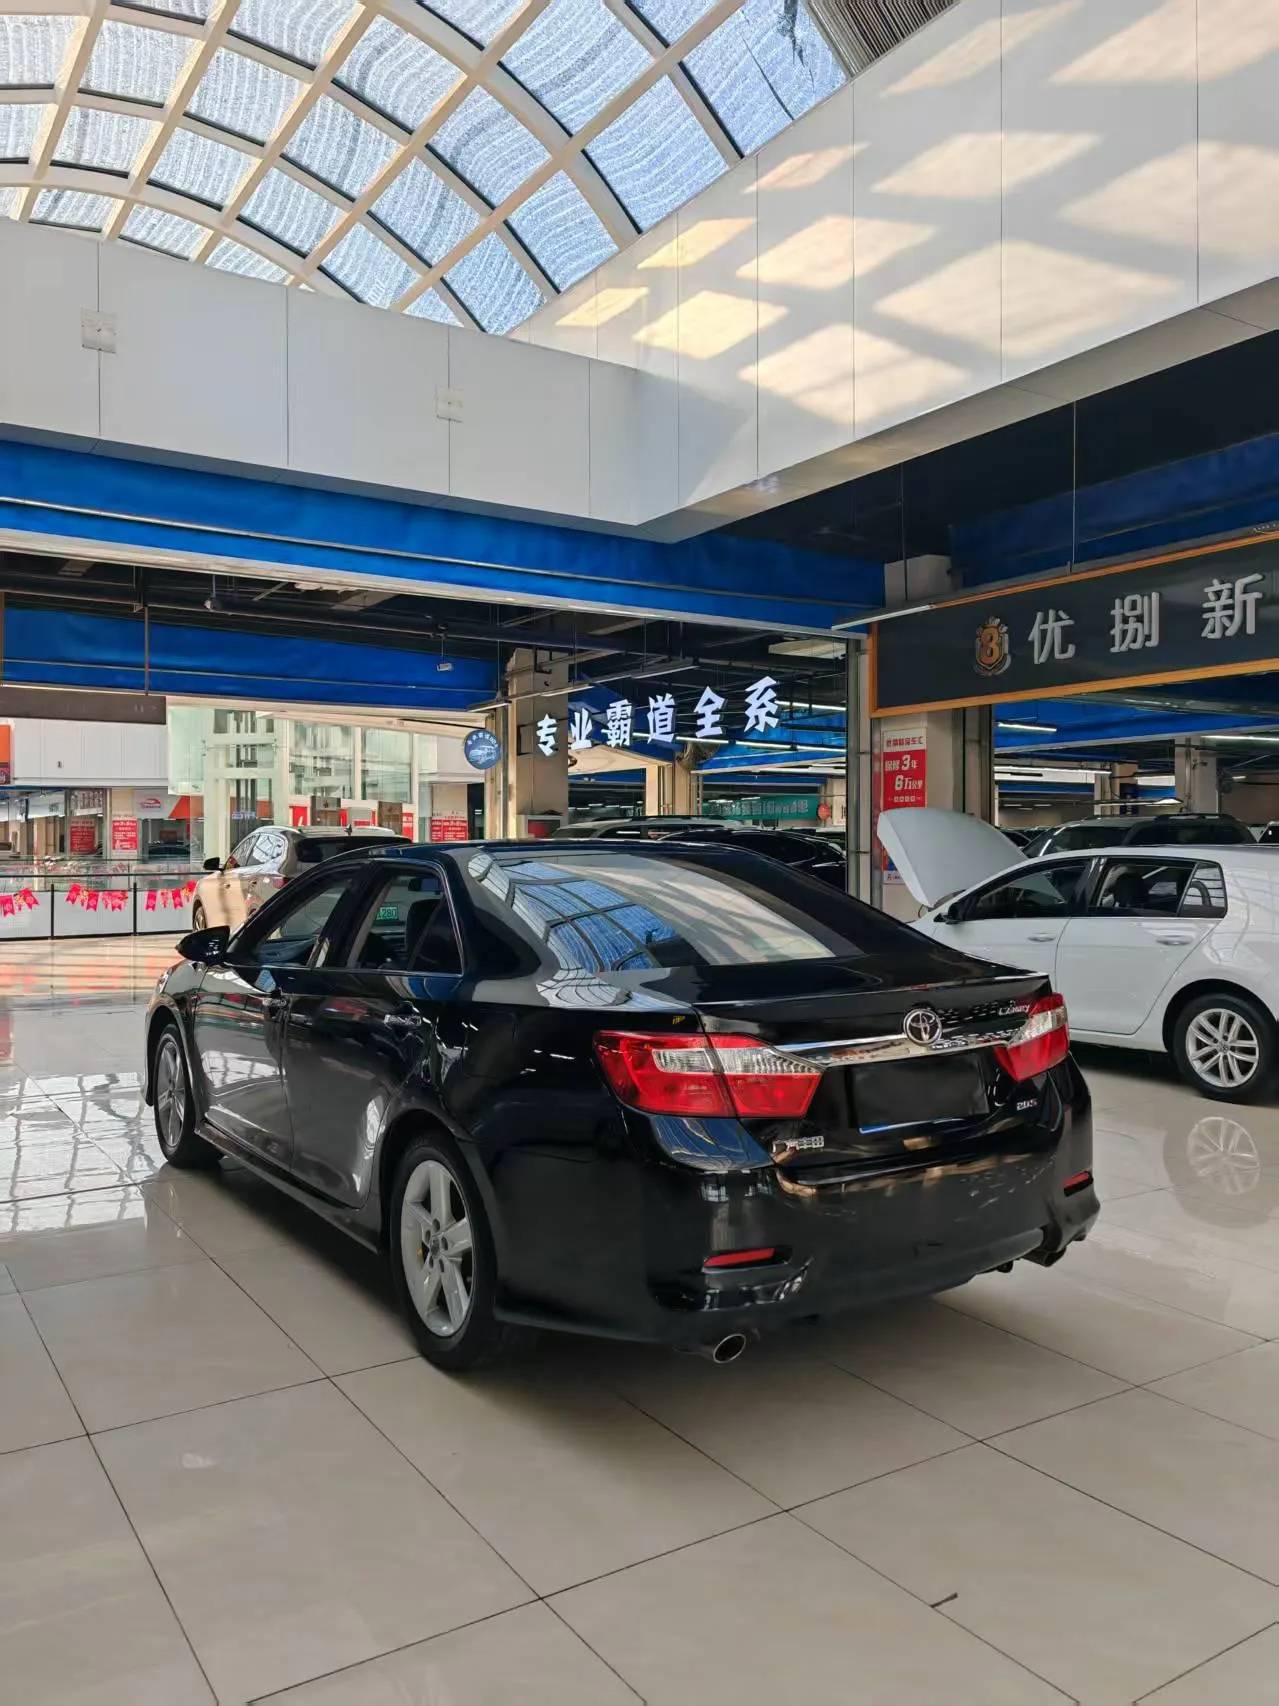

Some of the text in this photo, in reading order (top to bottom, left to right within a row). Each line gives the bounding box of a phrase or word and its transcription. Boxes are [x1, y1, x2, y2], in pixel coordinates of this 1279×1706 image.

[1028, 572, 1267, 665] 优捌新
[536, 675, 781, 758] 专业霸道全系
